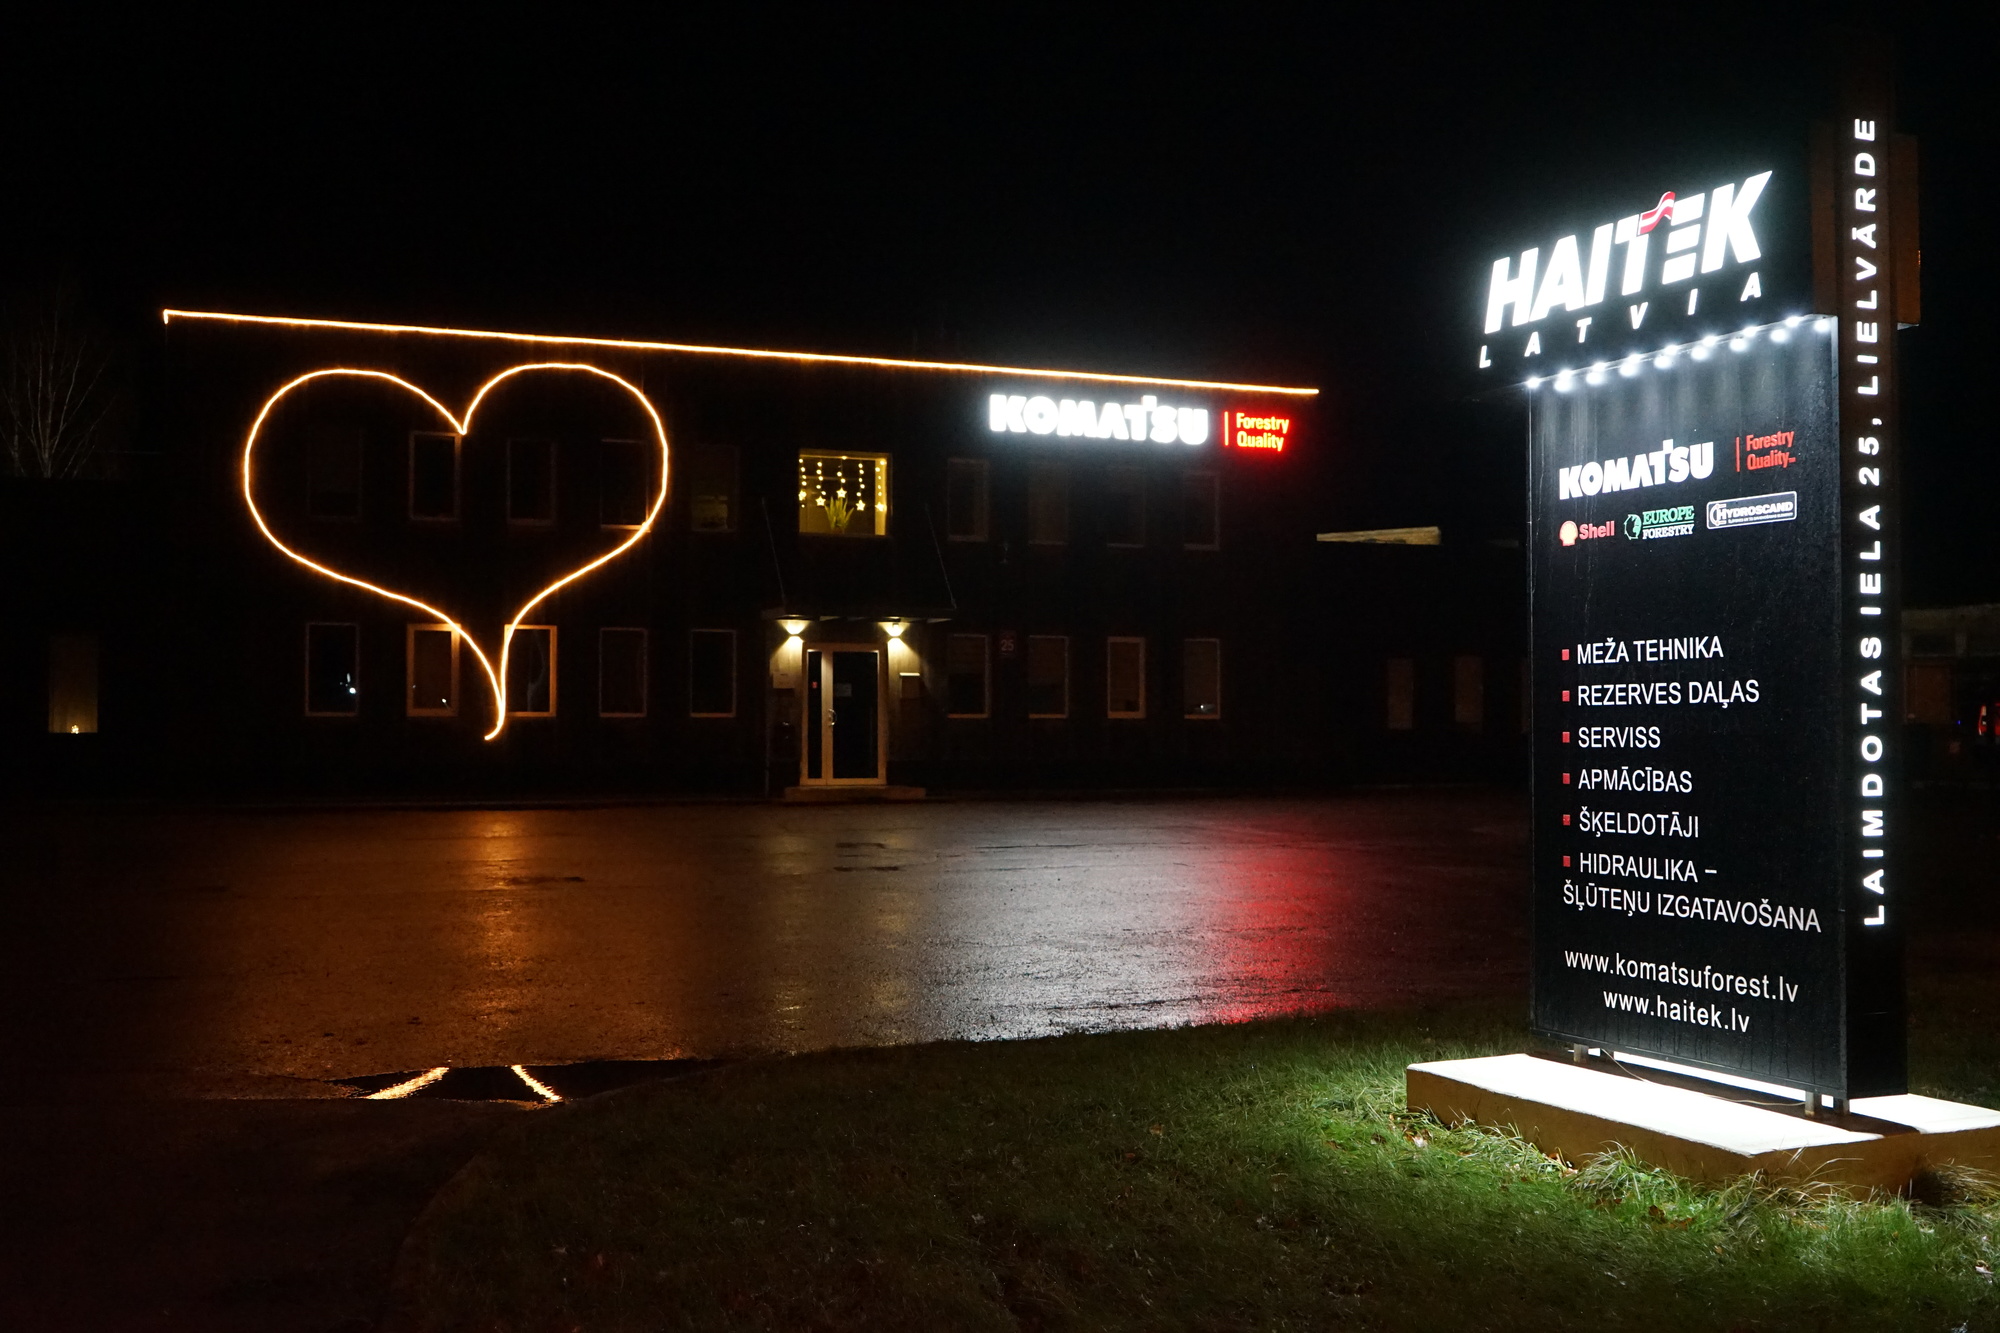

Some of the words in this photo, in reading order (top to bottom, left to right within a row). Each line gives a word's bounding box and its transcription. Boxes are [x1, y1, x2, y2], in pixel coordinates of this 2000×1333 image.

[1484, 170, 1773, 335] HAITEK
[1852, 118, 1879, 396] LIELVĀRDE
[1479, 271, 1762, 369] LATVIA
[989, 393, 1209, 445] KOMATSU
[1236, 412, 1289, 434] Forestry
[1237, 431, 1285, 452] Quality
[1746, 431, 1795, 452] Forestry
[1858, 417, 1883, 487] 25,
[1558, 438, 1714, 500] KOMATSU
[1643, 505, 1695, 526] EUROPE
[1717, 501, 1794, 520] HYDROSCAND
[1579, 520, 1615, 540] Shell
[1643, 523, 1695, 540] FORESTRY
[1859, 504, 1882, 615] IELA
[1001, 639, 1015, 651] 25
[1577, 637, 1629, 665] MEŽA
[1633, 635, 1724, 662] TEHNIKA
[1577, 682, 1682, 706] REZERVES
[1688, 679, 1760, 708] DAĻAS
[1578, 726, 1661, 748] SERVISS
[1578, 766, 1693, 793] APMĀCĪBAS
[1860, 636, 1885, 926] LAIMDOTAS
[1579, 806, 1699, 838] ŠĶELDOTĀJI
[1579, 852, 1698, 882] HIDRAULIKA
[1563, 879, 1650, 916] ŠĻŪTEŅU
[1657, 893, 1821, 933] IZGATAVOŠANA
[1565, 950, 1799, 1003] www.komatsuforest.lv
[1603, 990, 1750, 1033] www.haitek.lv
